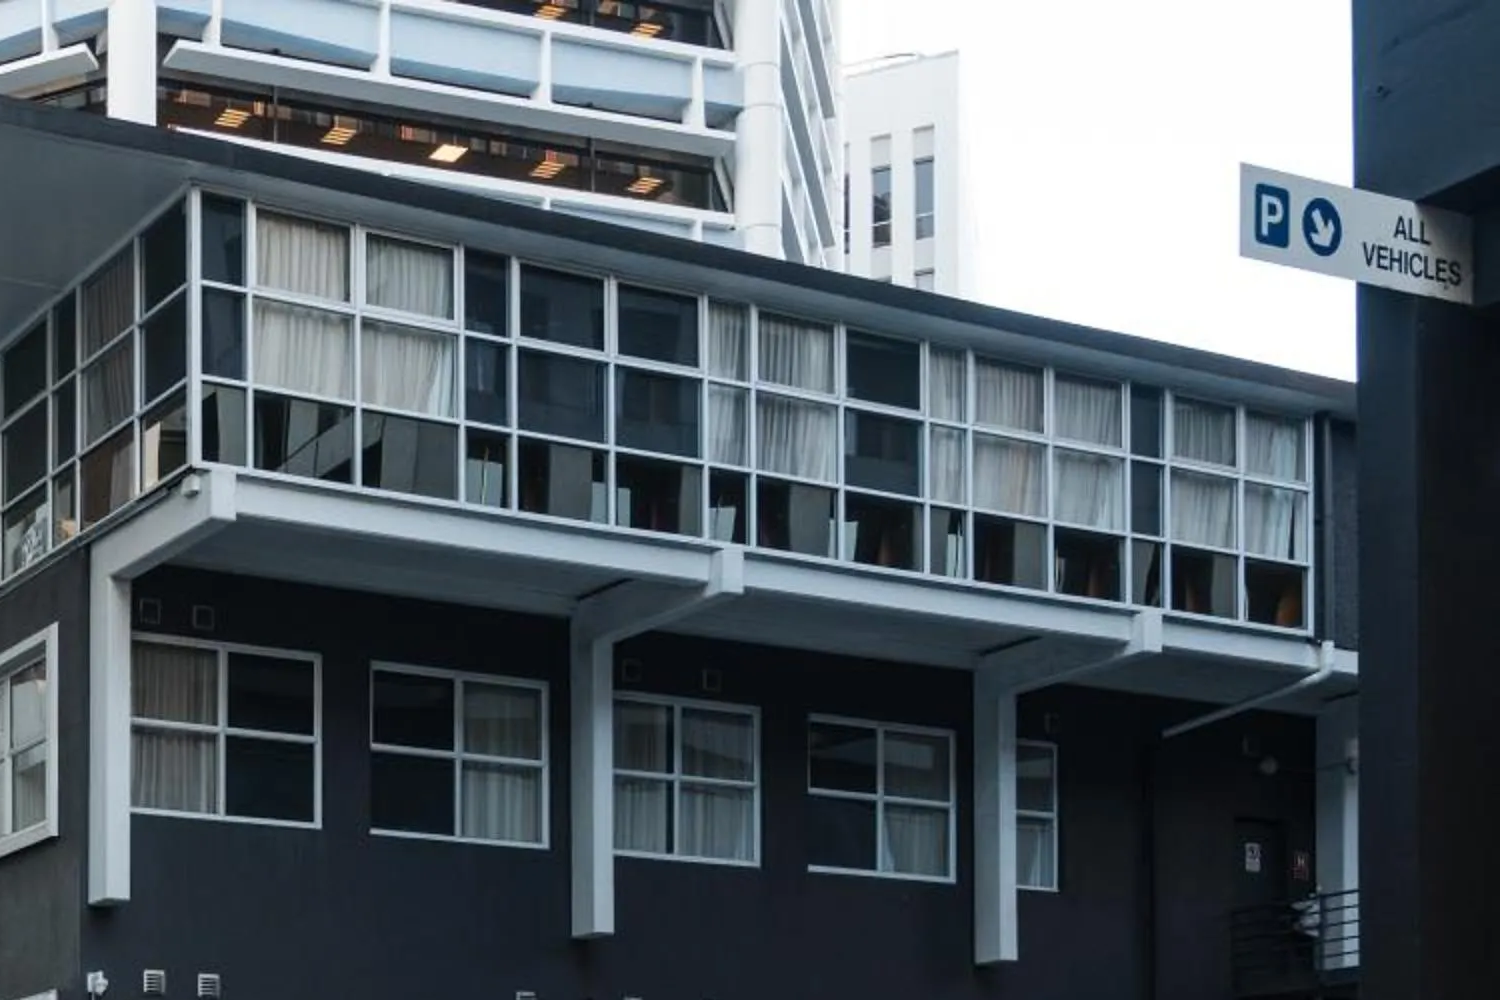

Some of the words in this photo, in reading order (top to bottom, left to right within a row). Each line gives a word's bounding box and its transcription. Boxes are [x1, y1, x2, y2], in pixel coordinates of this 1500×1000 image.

[1261, 193, 1284, 236] P
[1394, 215, 1432, 245] ALL
[1362, 241, 1462, 286] VEHICLES
